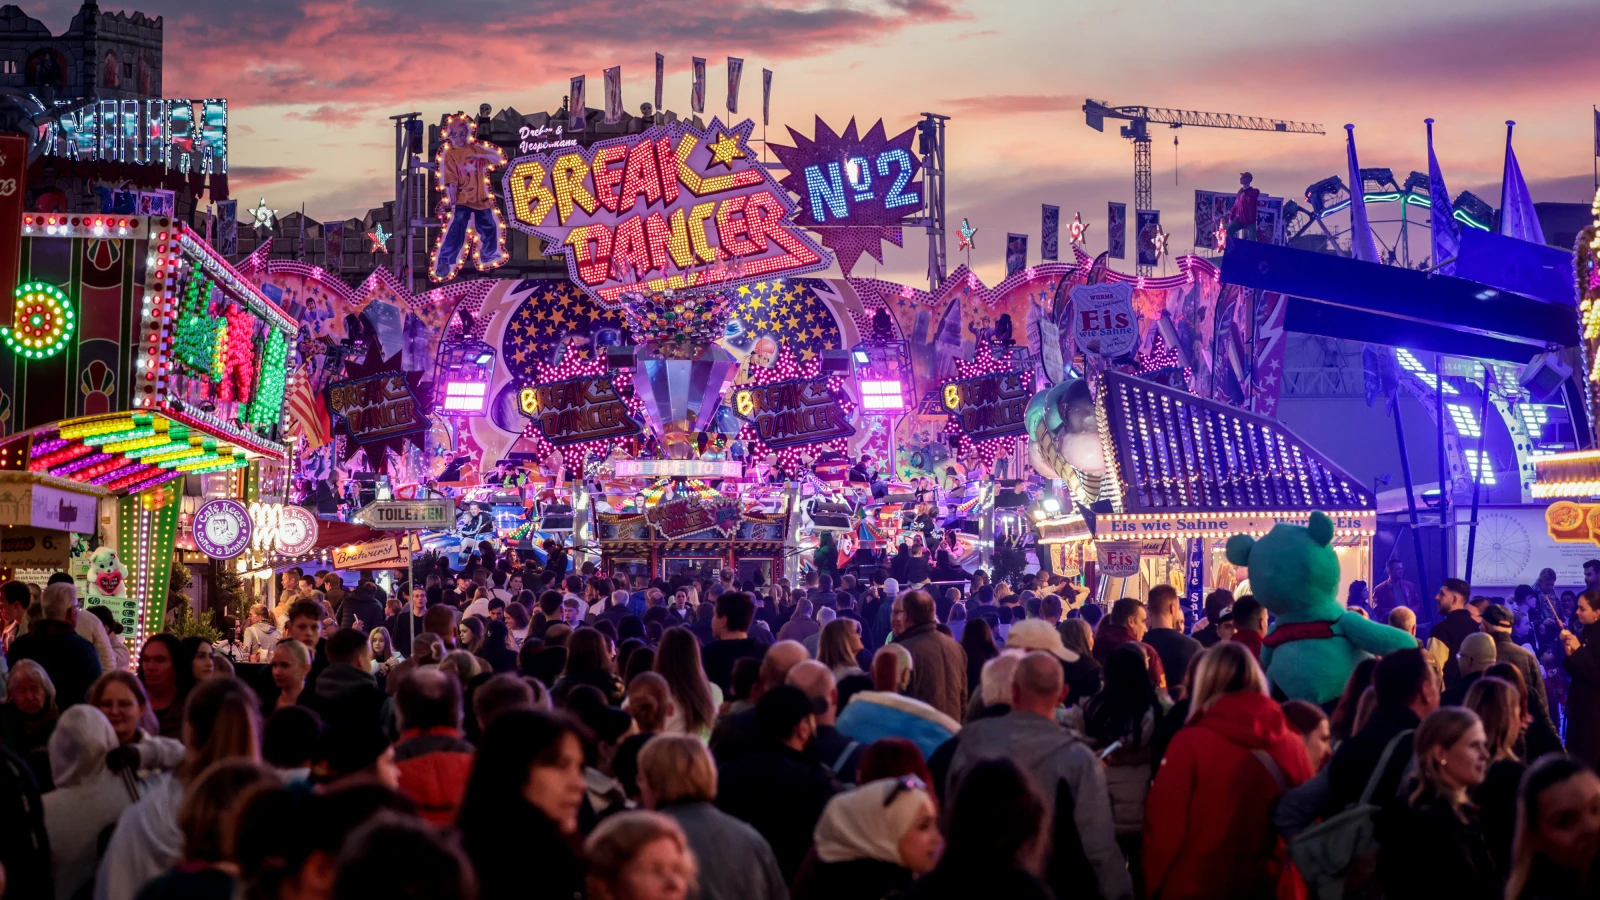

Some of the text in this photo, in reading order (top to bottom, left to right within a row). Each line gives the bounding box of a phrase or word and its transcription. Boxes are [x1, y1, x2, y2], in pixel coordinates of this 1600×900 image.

[555, 125, 563, 135] &
[509, 131, 765, 226] BREAK
[563, 190, 821, 296] DANCER
[1079, 326, 1132, 338] wie Sahne
[1080, 309, 1129, 331] Eis
[330, 373, 411, 413] BREAK
[520, 376, 617, 415] BREAK
[735, 380, 832, 417] BREAK
[943, 376, 1025, 412] BREAK
[348, 399, 430, 441] DANCER
[539, 405, 641, 442] DANCER
[755, 405, 855, 444] DANCER
[199, 502, 247, 528] Café Keese
[377, 507, 443, 521] TOILETTEN
[1111, 517, 1229, 532] Eis wie Sahne
[197, 531, 215, 553] Coffee
[224, 535, 247, 555] Drinks
[337, 544, 393, 564] Bratwurst
[1106, 551, 1133, 566] Eis
